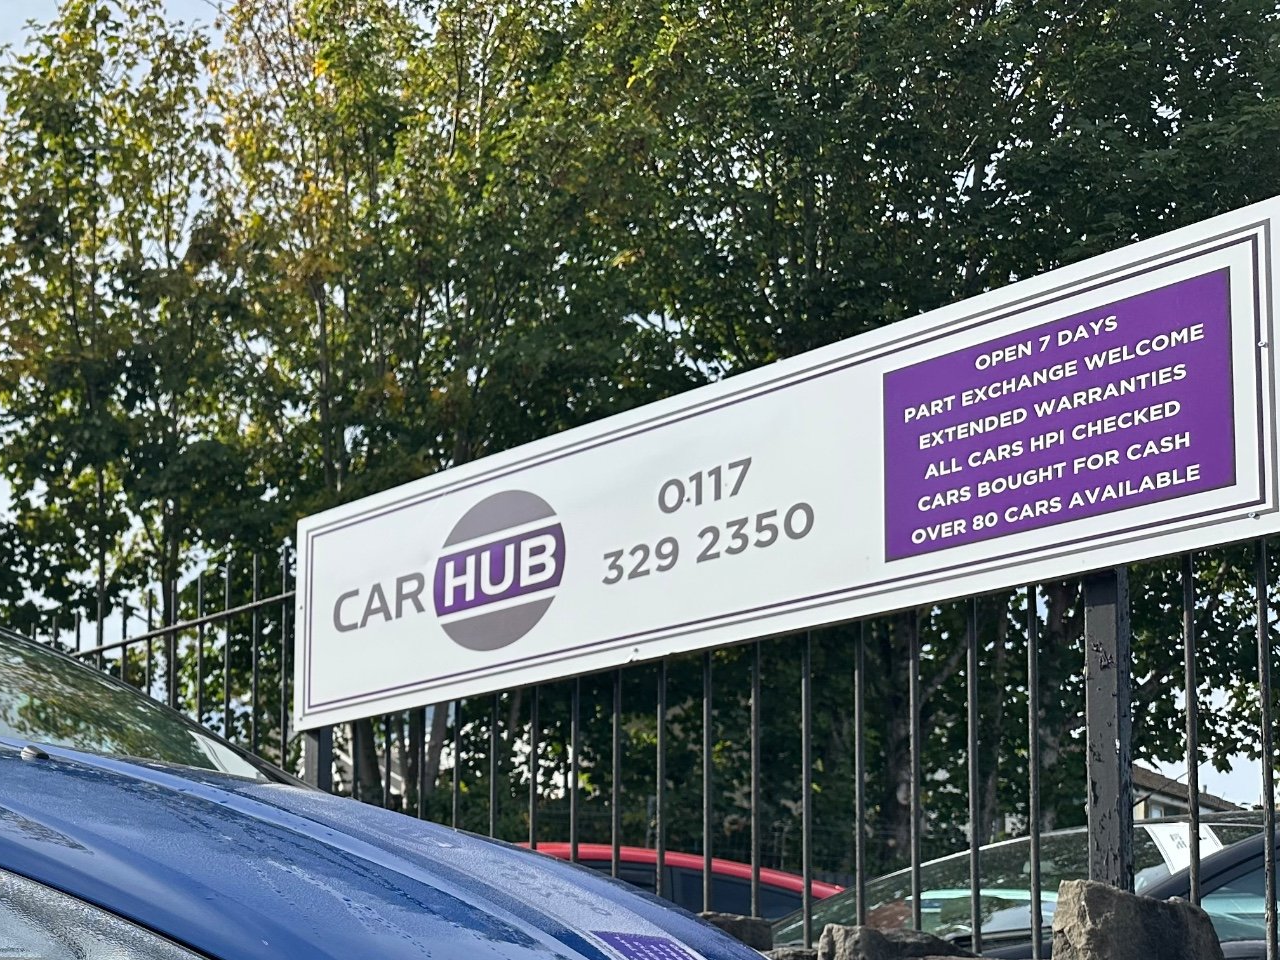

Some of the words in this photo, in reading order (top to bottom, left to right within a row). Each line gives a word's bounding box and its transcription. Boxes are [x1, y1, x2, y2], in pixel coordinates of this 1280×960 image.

[904, 395, 956, 423] PART
[961, 359, 1078, 407] EXCHANGE
[1084, 323, 1205, 371] WELCOME
[975, 340, 1032, 371] OPEN
[1038, 334, 1051, 353] 7
[1057, 315, 1118, 347] DAYS
[919, 408, 1028, 450] EXTENDED
[1034, 363, 1187, 418] WARRANTIES
[924, 457, 963, 480] ALL
[967, 440, 1024, 468] CARS
[1030, 429, 1065, 452] HPI
[1071, 400, 1181, 441] CHECKED
[657, 457, 753, 514] 0117
[911, 519, 967, 544] OVER
[972, 511, 998, 531] 80
[1004, 497, 1062, 523] CARS
[1068, 464, 1201, 509] AVAILABLE
[917, 485, 971, 512] CARS
[977, 462, 1067, 498] BOUGHT
[1073, 449, 1119, 475] FOR
[1126, 431, 1191, 461] CASH
[333, 572, 426, 633] CAR
[442, 532, 558, 608] HUB
[601, 536, 680, 585] 329
[696, 502, 816, 563] 2350
